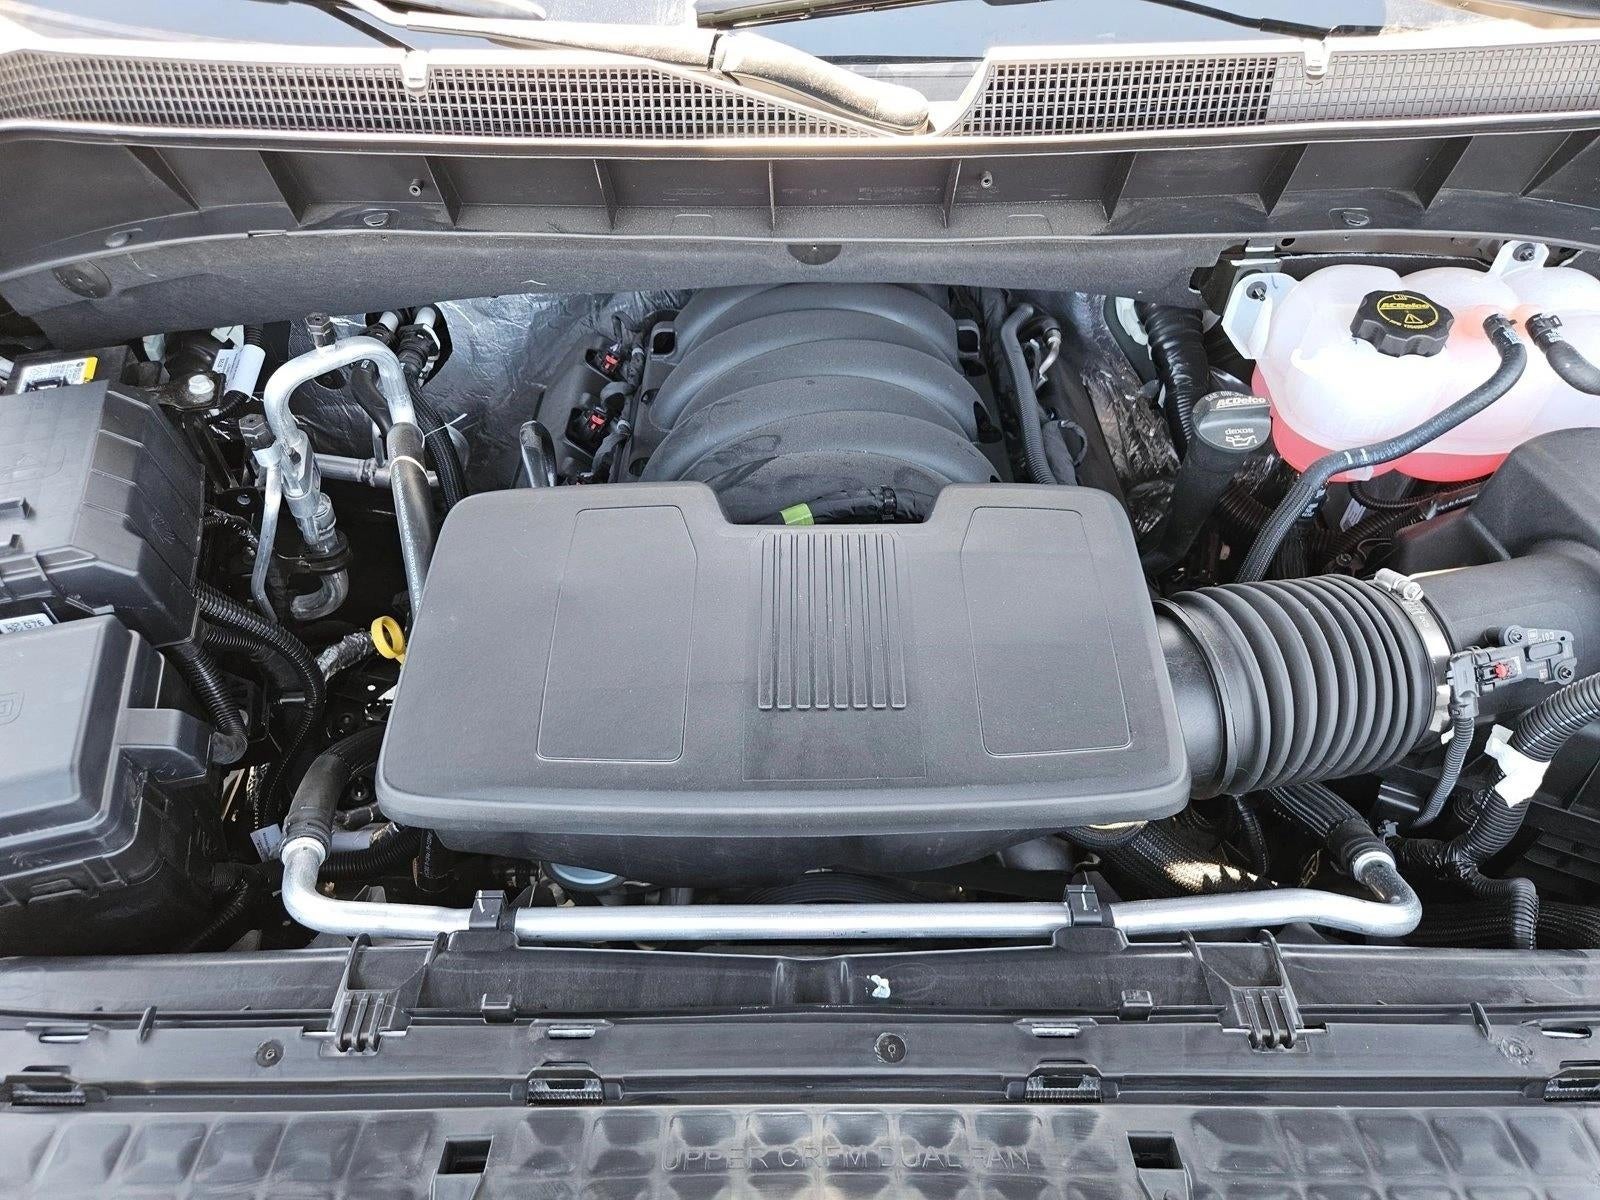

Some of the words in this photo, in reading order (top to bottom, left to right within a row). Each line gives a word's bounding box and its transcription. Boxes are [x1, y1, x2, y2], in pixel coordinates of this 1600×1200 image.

[1216, 396, 1266, 408] ACDelco
[661, 1147, 769, 1171] UPPER
[878, 1145, 963, 1169] DUAL
[970, 1145, 1030, 1170] FAN
